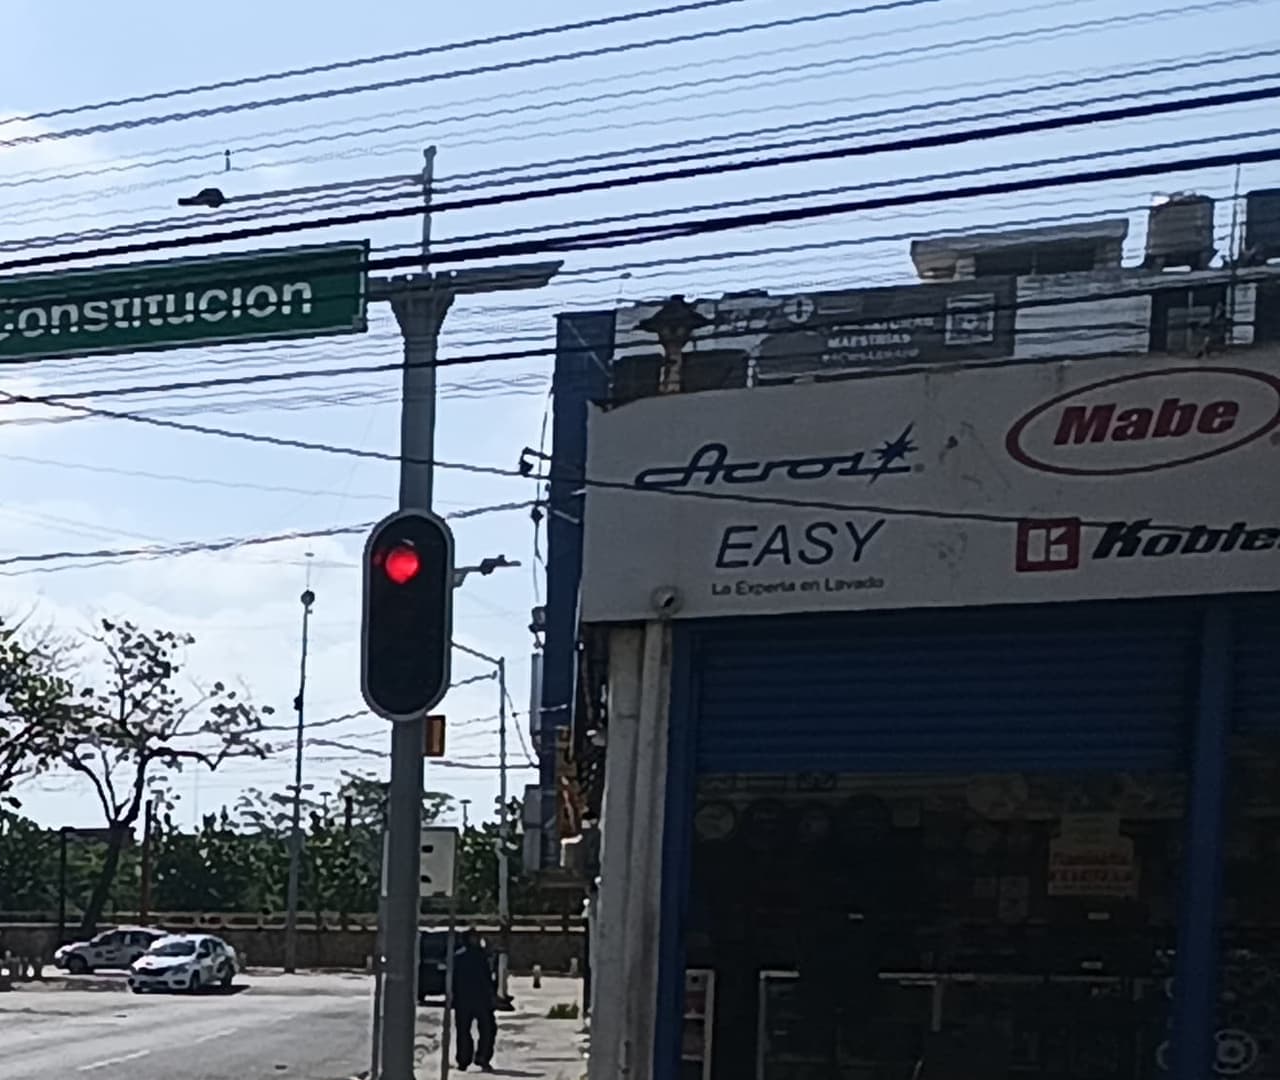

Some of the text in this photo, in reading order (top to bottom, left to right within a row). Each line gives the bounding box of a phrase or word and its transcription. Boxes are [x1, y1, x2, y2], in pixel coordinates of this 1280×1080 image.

[1053, 397, 1240, 445] Mabe
[634, 440, 911, 490] Acros
[715, 518, 886, 569] EASY
[1092, 519, 1280, 560] Koble
[711, 582, 732, 597] La
[800, 579, 820, 592] en
[824, 576, 884, 592] Lavado
